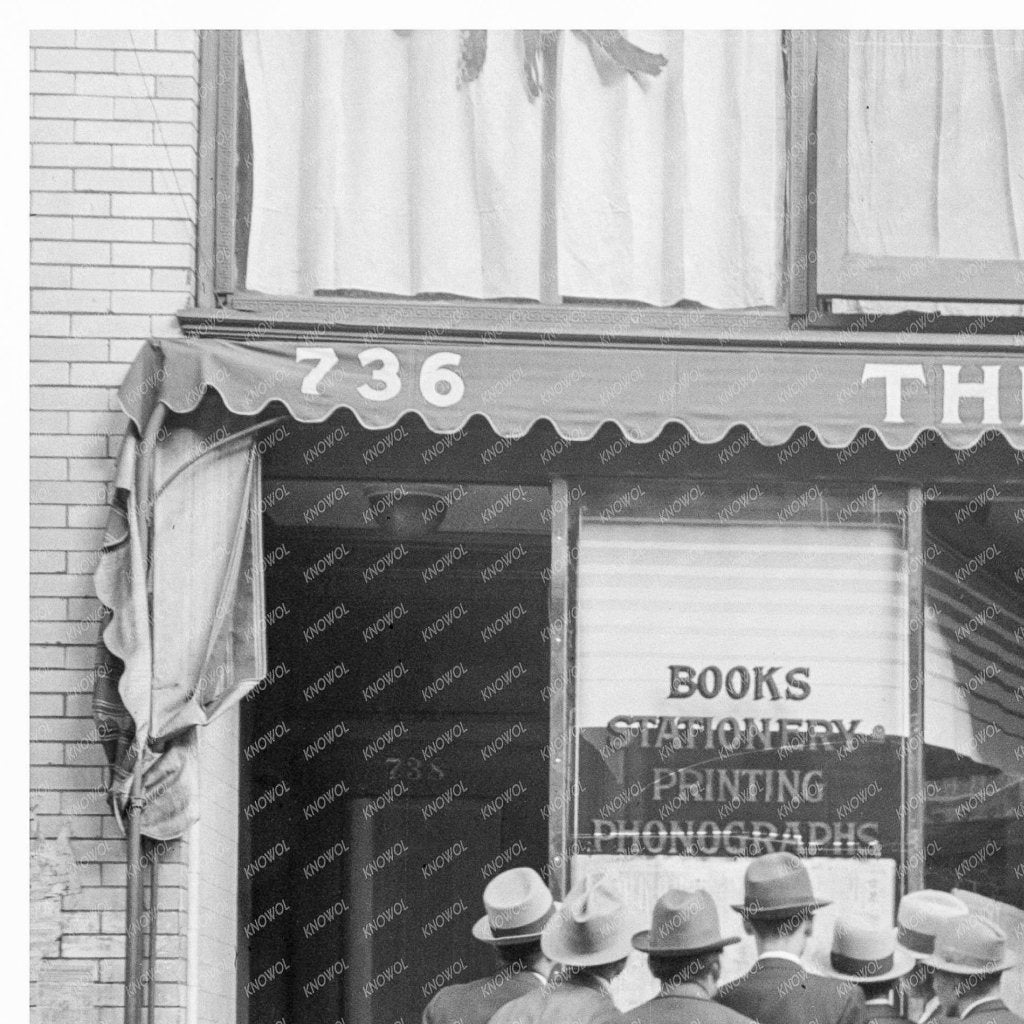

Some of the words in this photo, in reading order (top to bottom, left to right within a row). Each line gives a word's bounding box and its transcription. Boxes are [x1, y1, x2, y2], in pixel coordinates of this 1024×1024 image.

[295, 346, 466, 408] 736
[667, 664, 811, 701] BOOKS
[606, 715, 863, 752] STATIONERY
[652, 767, 825, 803] PRINTING
[591, 819, 882, 857] PHONOGRAPHS
